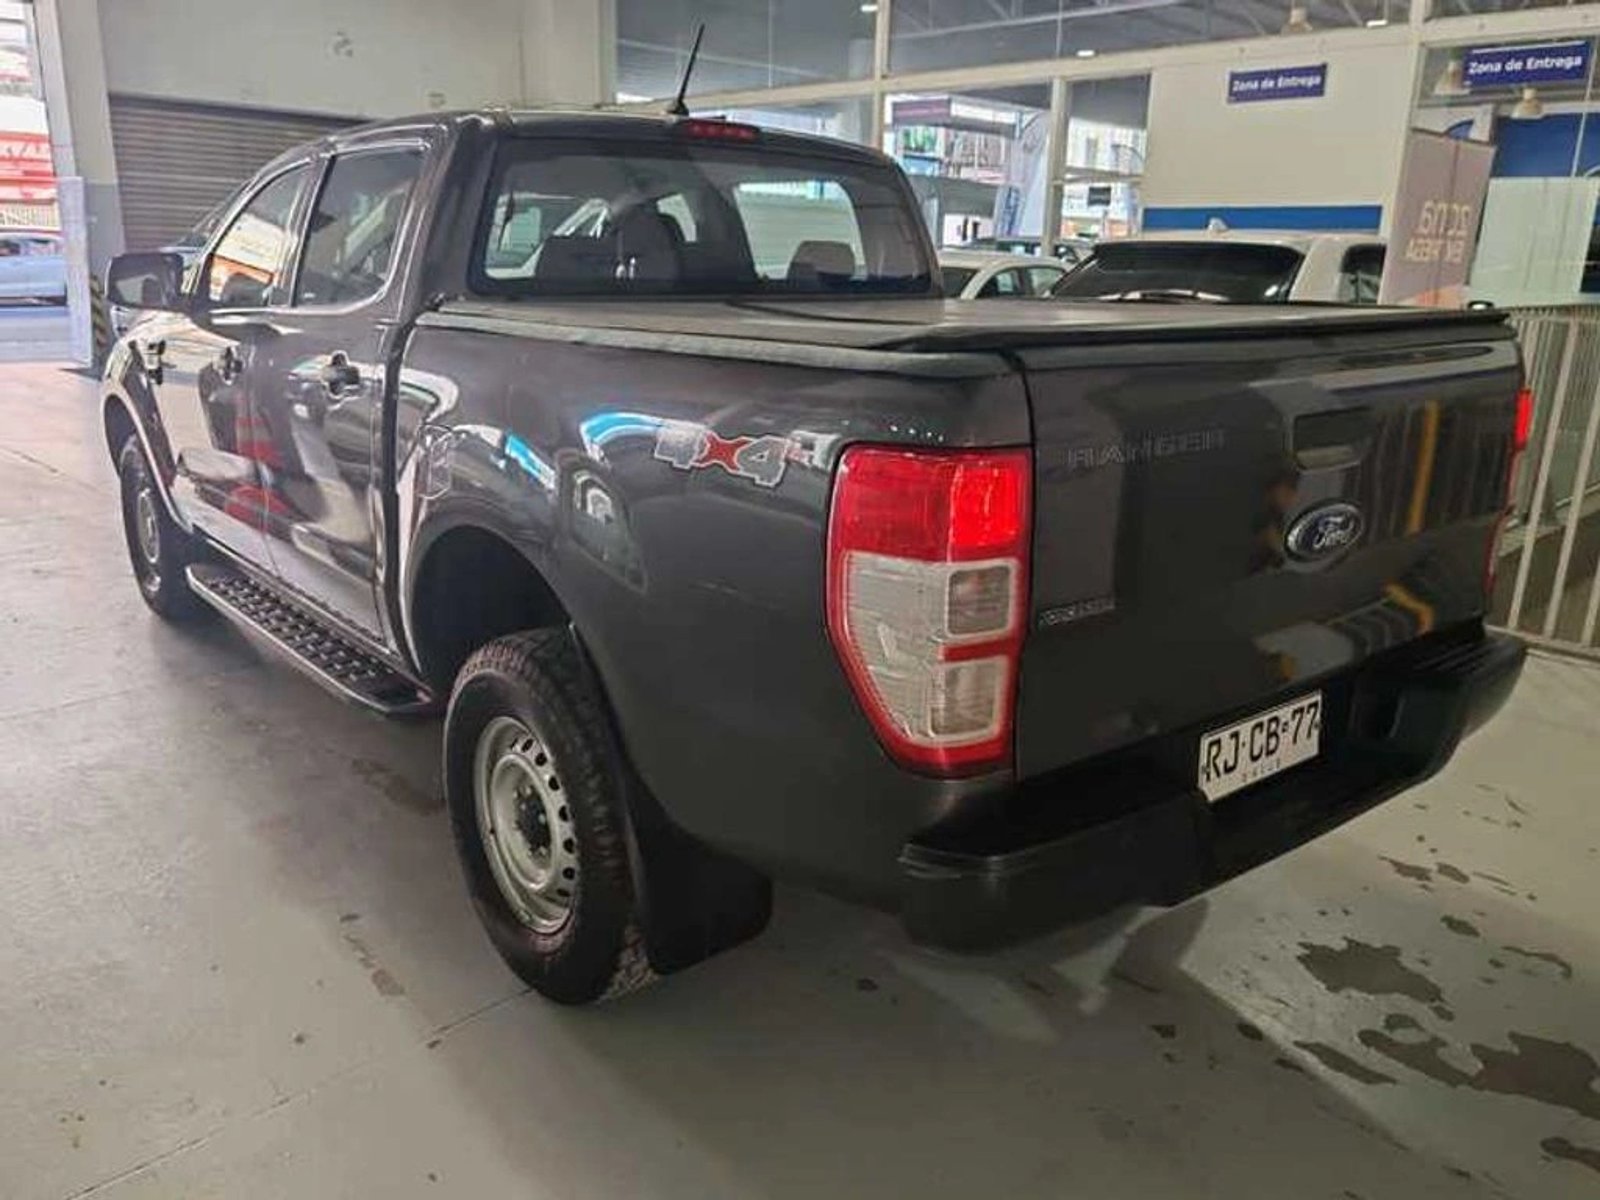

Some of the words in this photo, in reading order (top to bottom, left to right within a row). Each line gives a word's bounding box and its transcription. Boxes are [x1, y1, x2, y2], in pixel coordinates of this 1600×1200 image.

[1469, 61, 1502, 74] Zona
[1504, 58, 1523, 71] de
[1526, 56, 1582, 70] Entrega
[1232, 80, 1258, 92] Zona
[1261, 78, 1275, 89] de
[1277, 75, 1321, 88] Entrega
[1312, 512, 1355, 550] Ford
